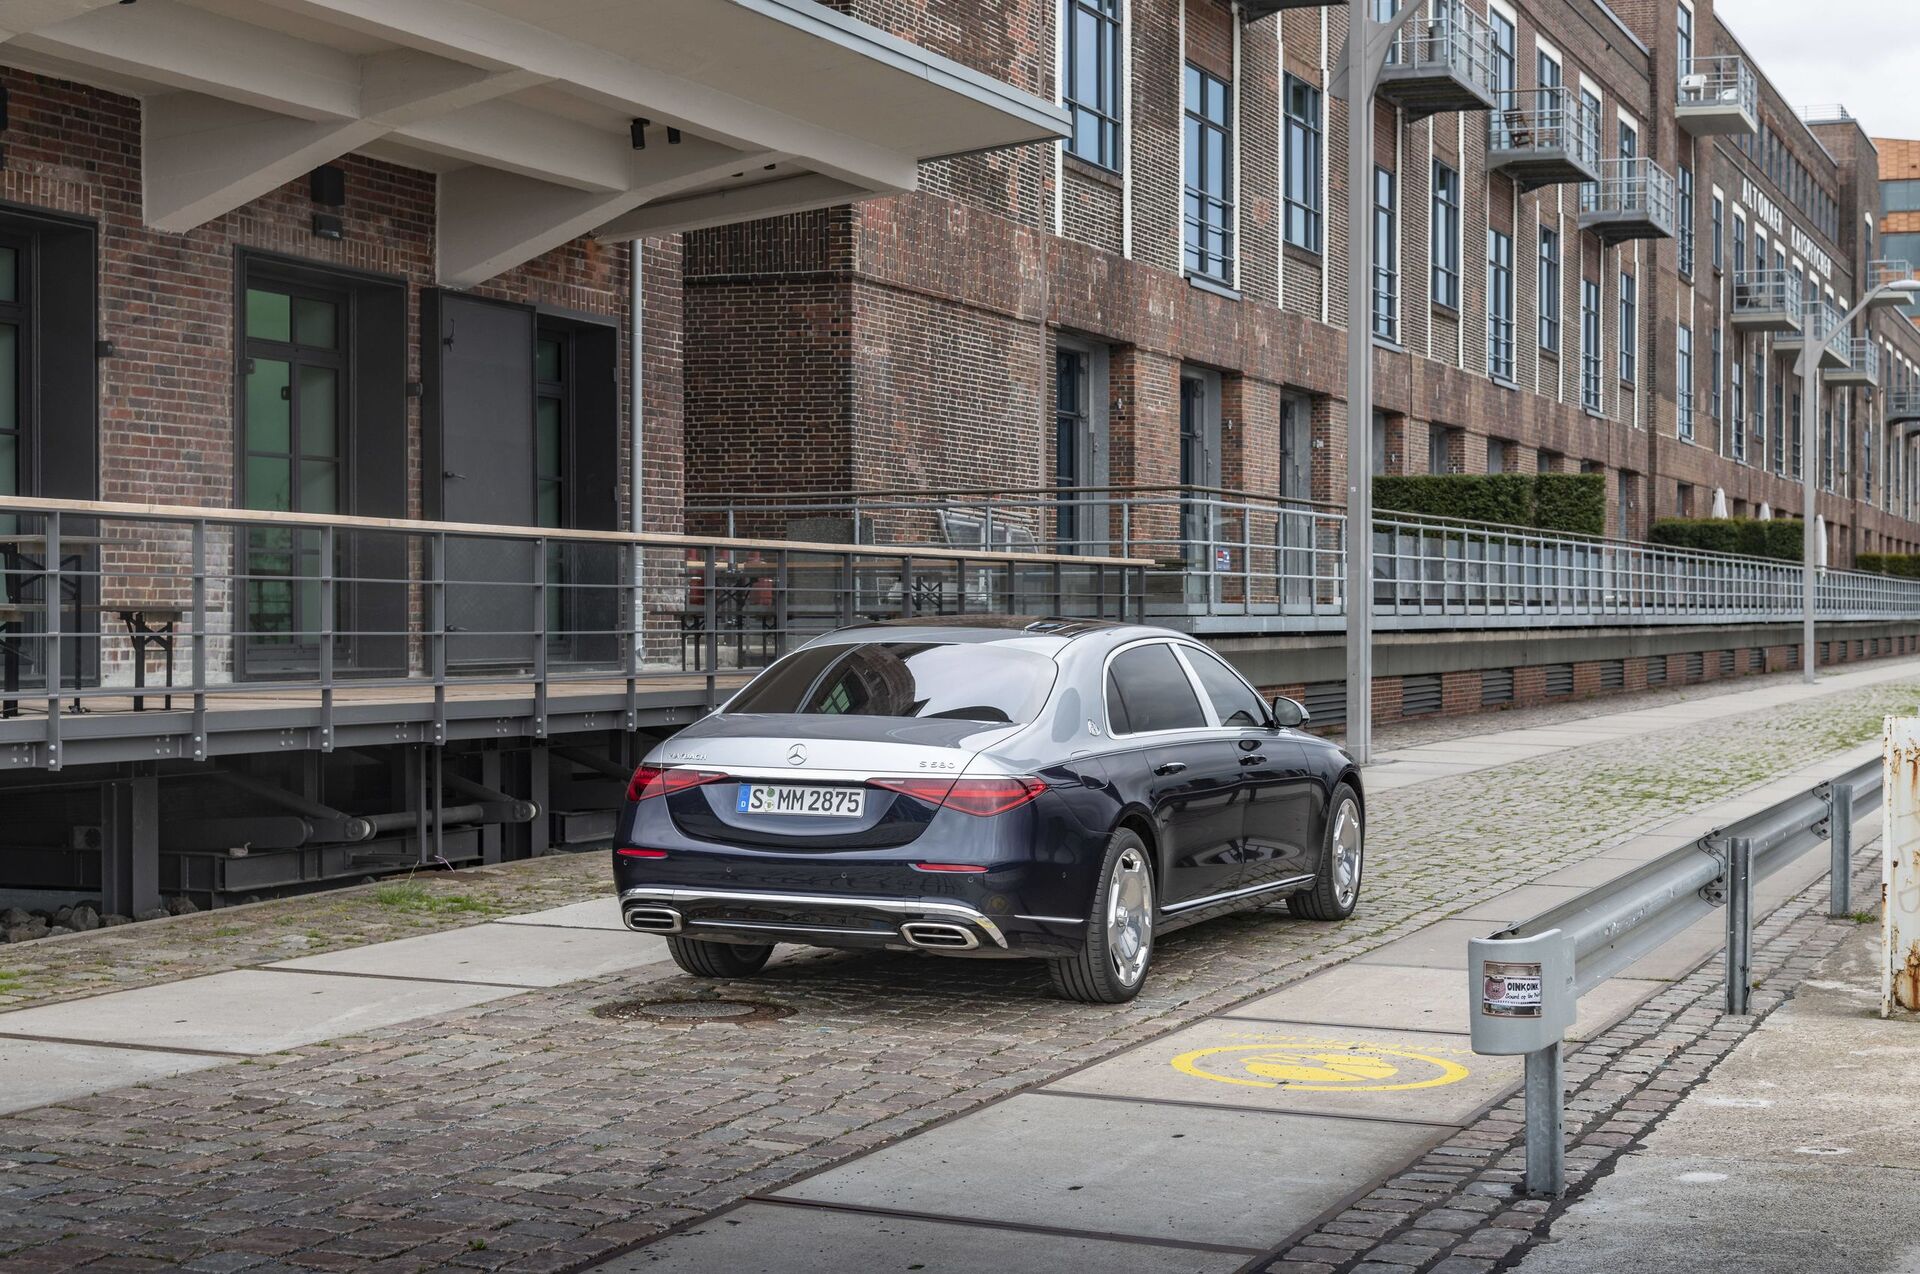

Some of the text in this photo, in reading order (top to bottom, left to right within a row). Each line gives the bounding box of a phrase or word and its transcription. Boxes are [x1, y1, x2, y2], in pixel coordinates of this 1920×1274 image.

[1742, 178, 1832, 281] ALTONAER KAISPEICHER
[750, 788, 861, 813] S MM 2875
